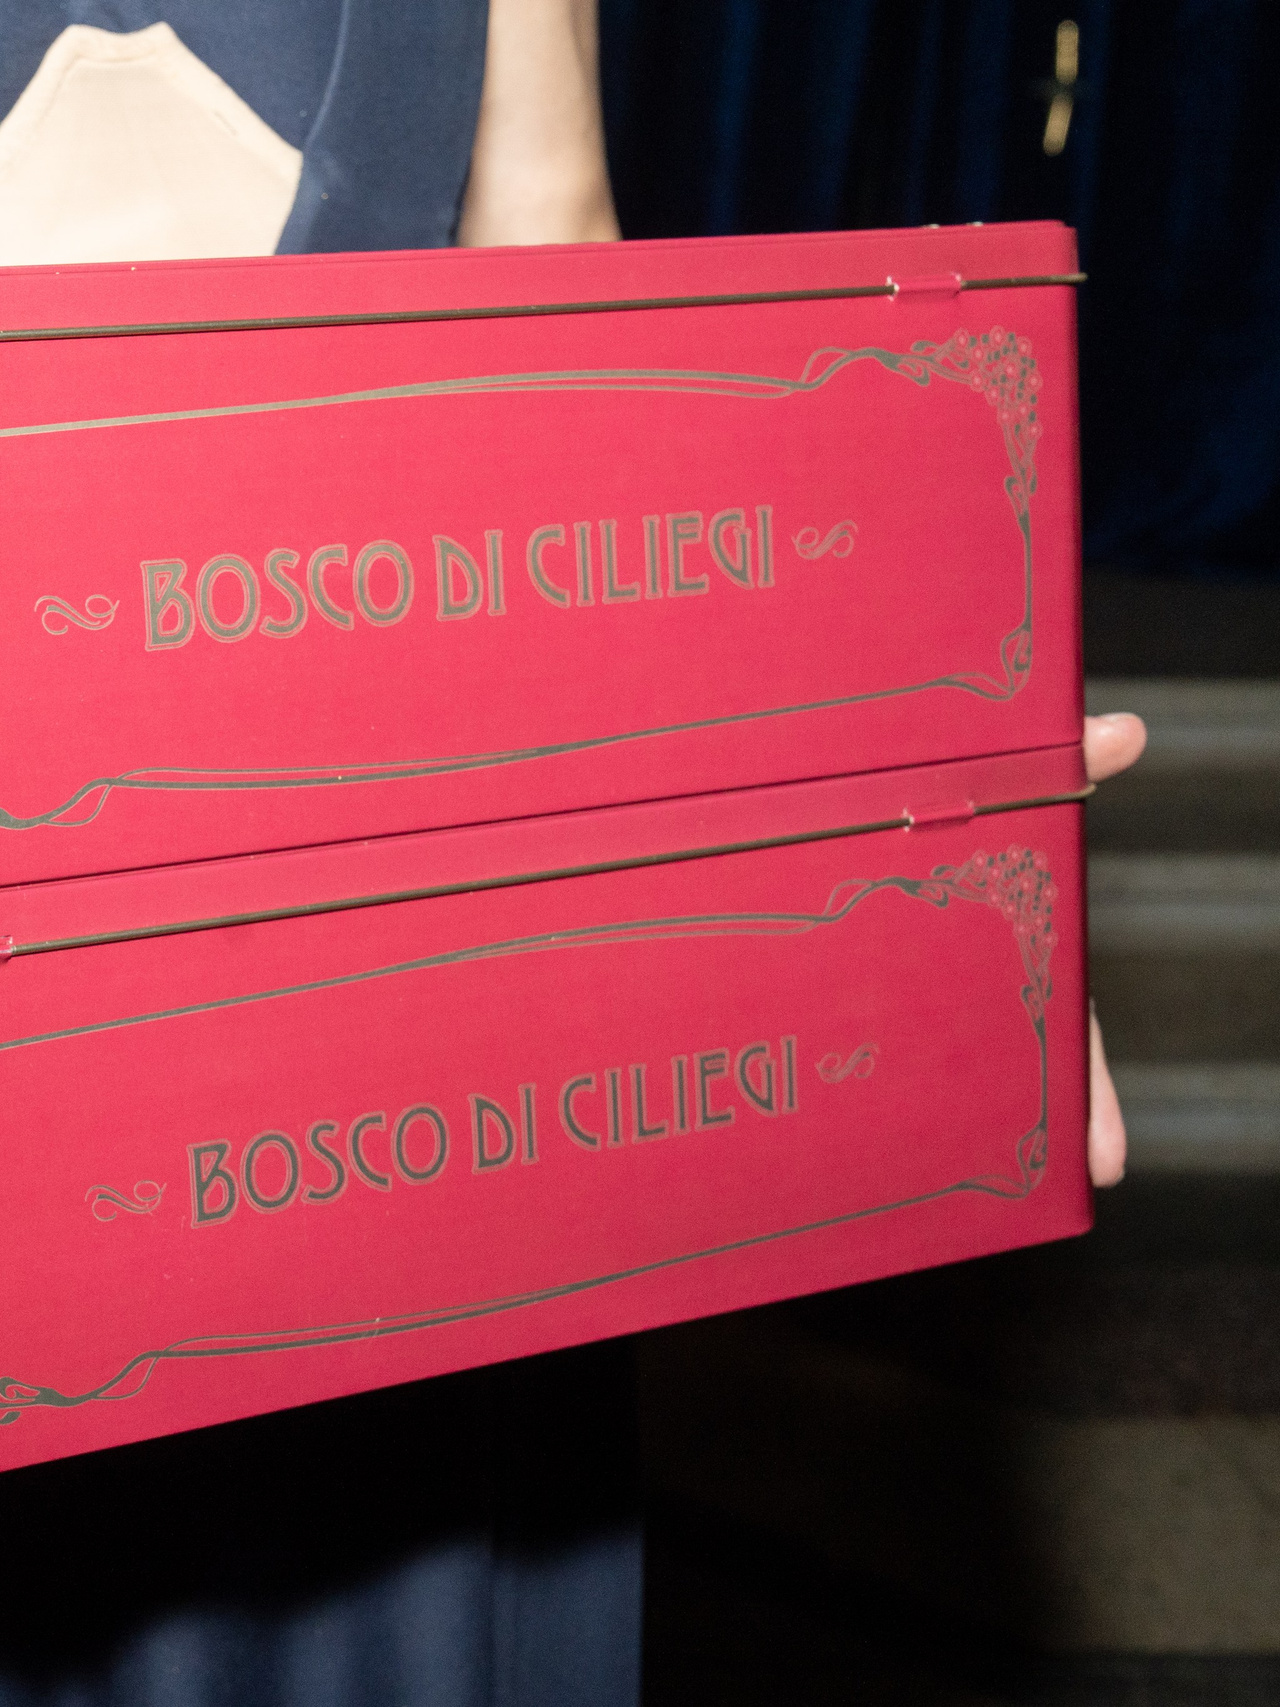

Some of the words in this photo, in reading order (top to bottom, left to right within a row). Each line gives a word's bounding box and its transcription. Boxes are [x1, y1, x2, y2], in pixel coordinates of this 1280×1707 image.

[140, 539, 415, 651] BOSCO
[432, 529, 506, 622] DI
[526, 504, 774, 609] CILIEGI
[186, 1102, 451, 1228] BOSCO
[469, 1083, 537, 1174] DI
[559, 1036, 797, 1150] CILIEGI
